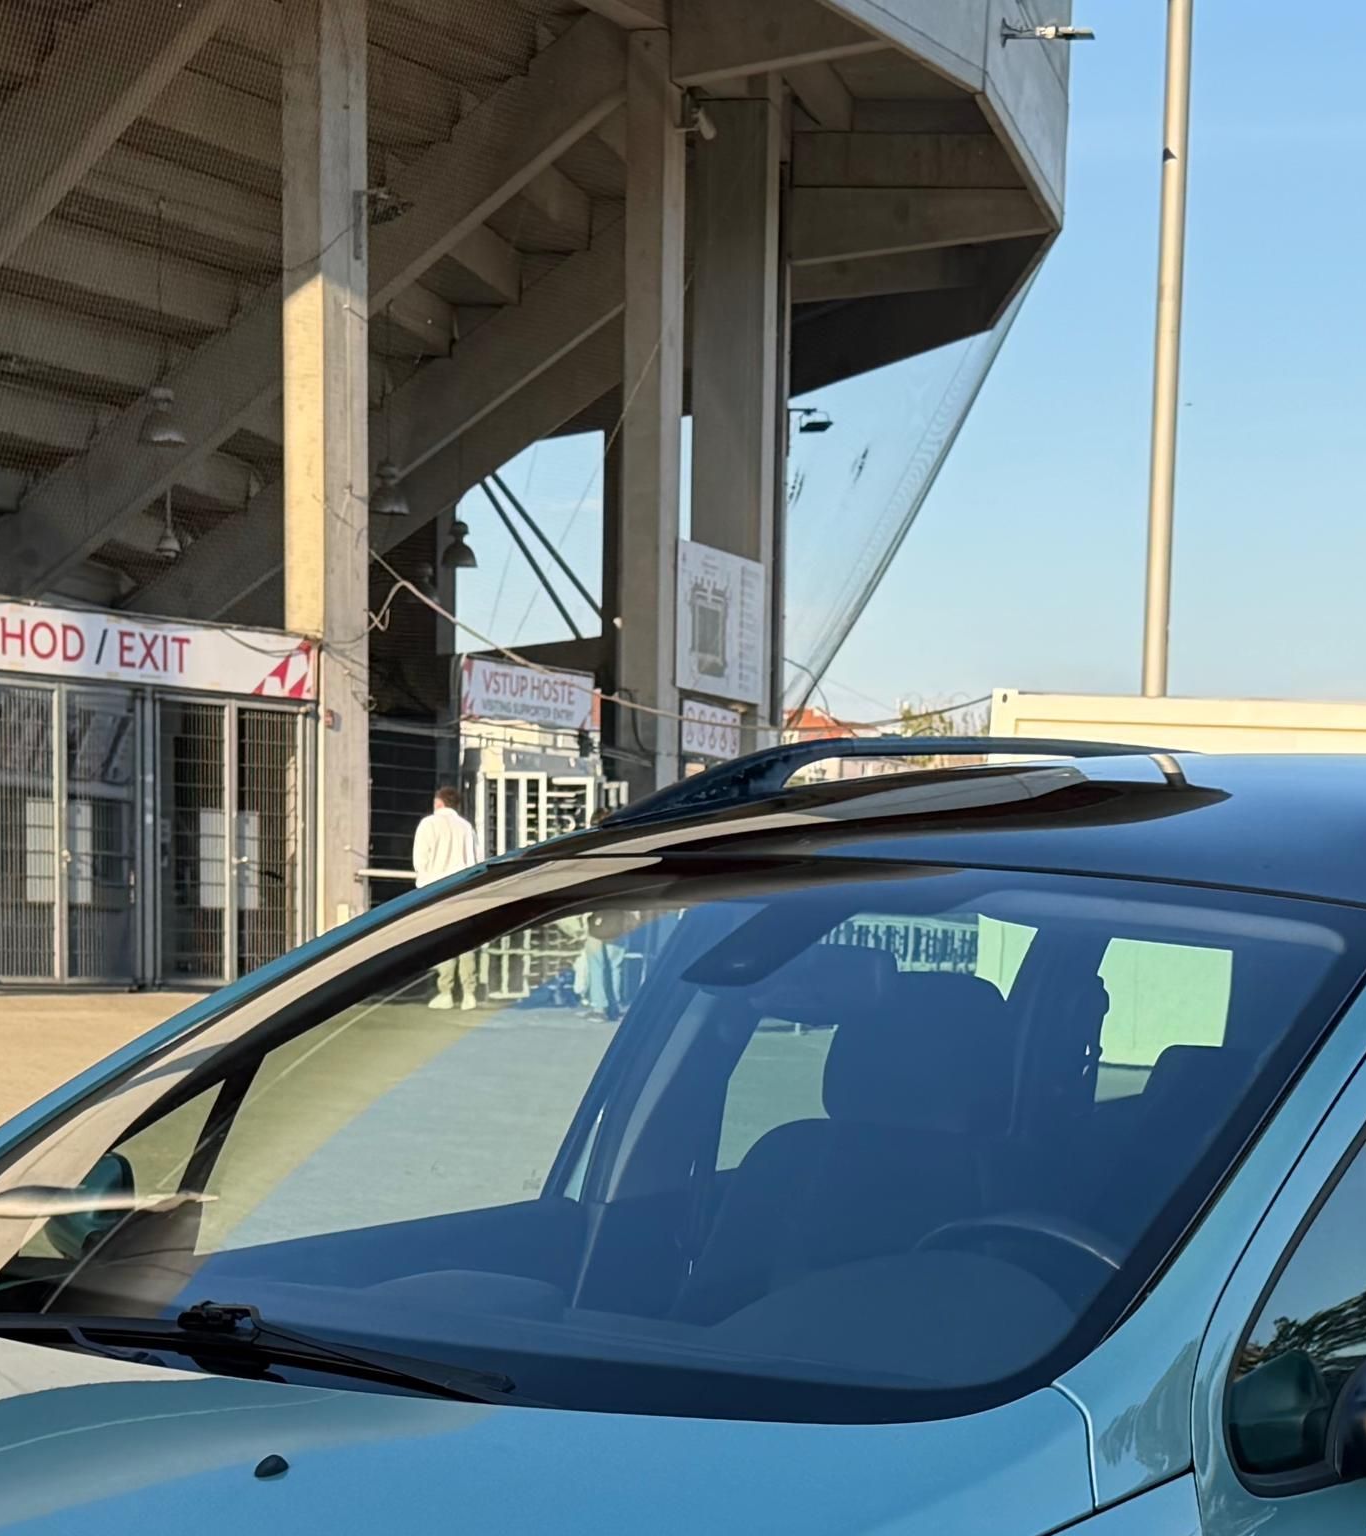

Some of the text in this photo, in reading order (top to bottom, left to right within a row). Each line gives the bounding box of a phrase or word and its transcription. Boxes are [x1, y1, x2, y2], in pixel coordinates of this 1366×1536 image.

[95, 629, 108, 665] /
[117, 629, 191, 673] EXIT
[483, 669, 528, 697] VSTUP
